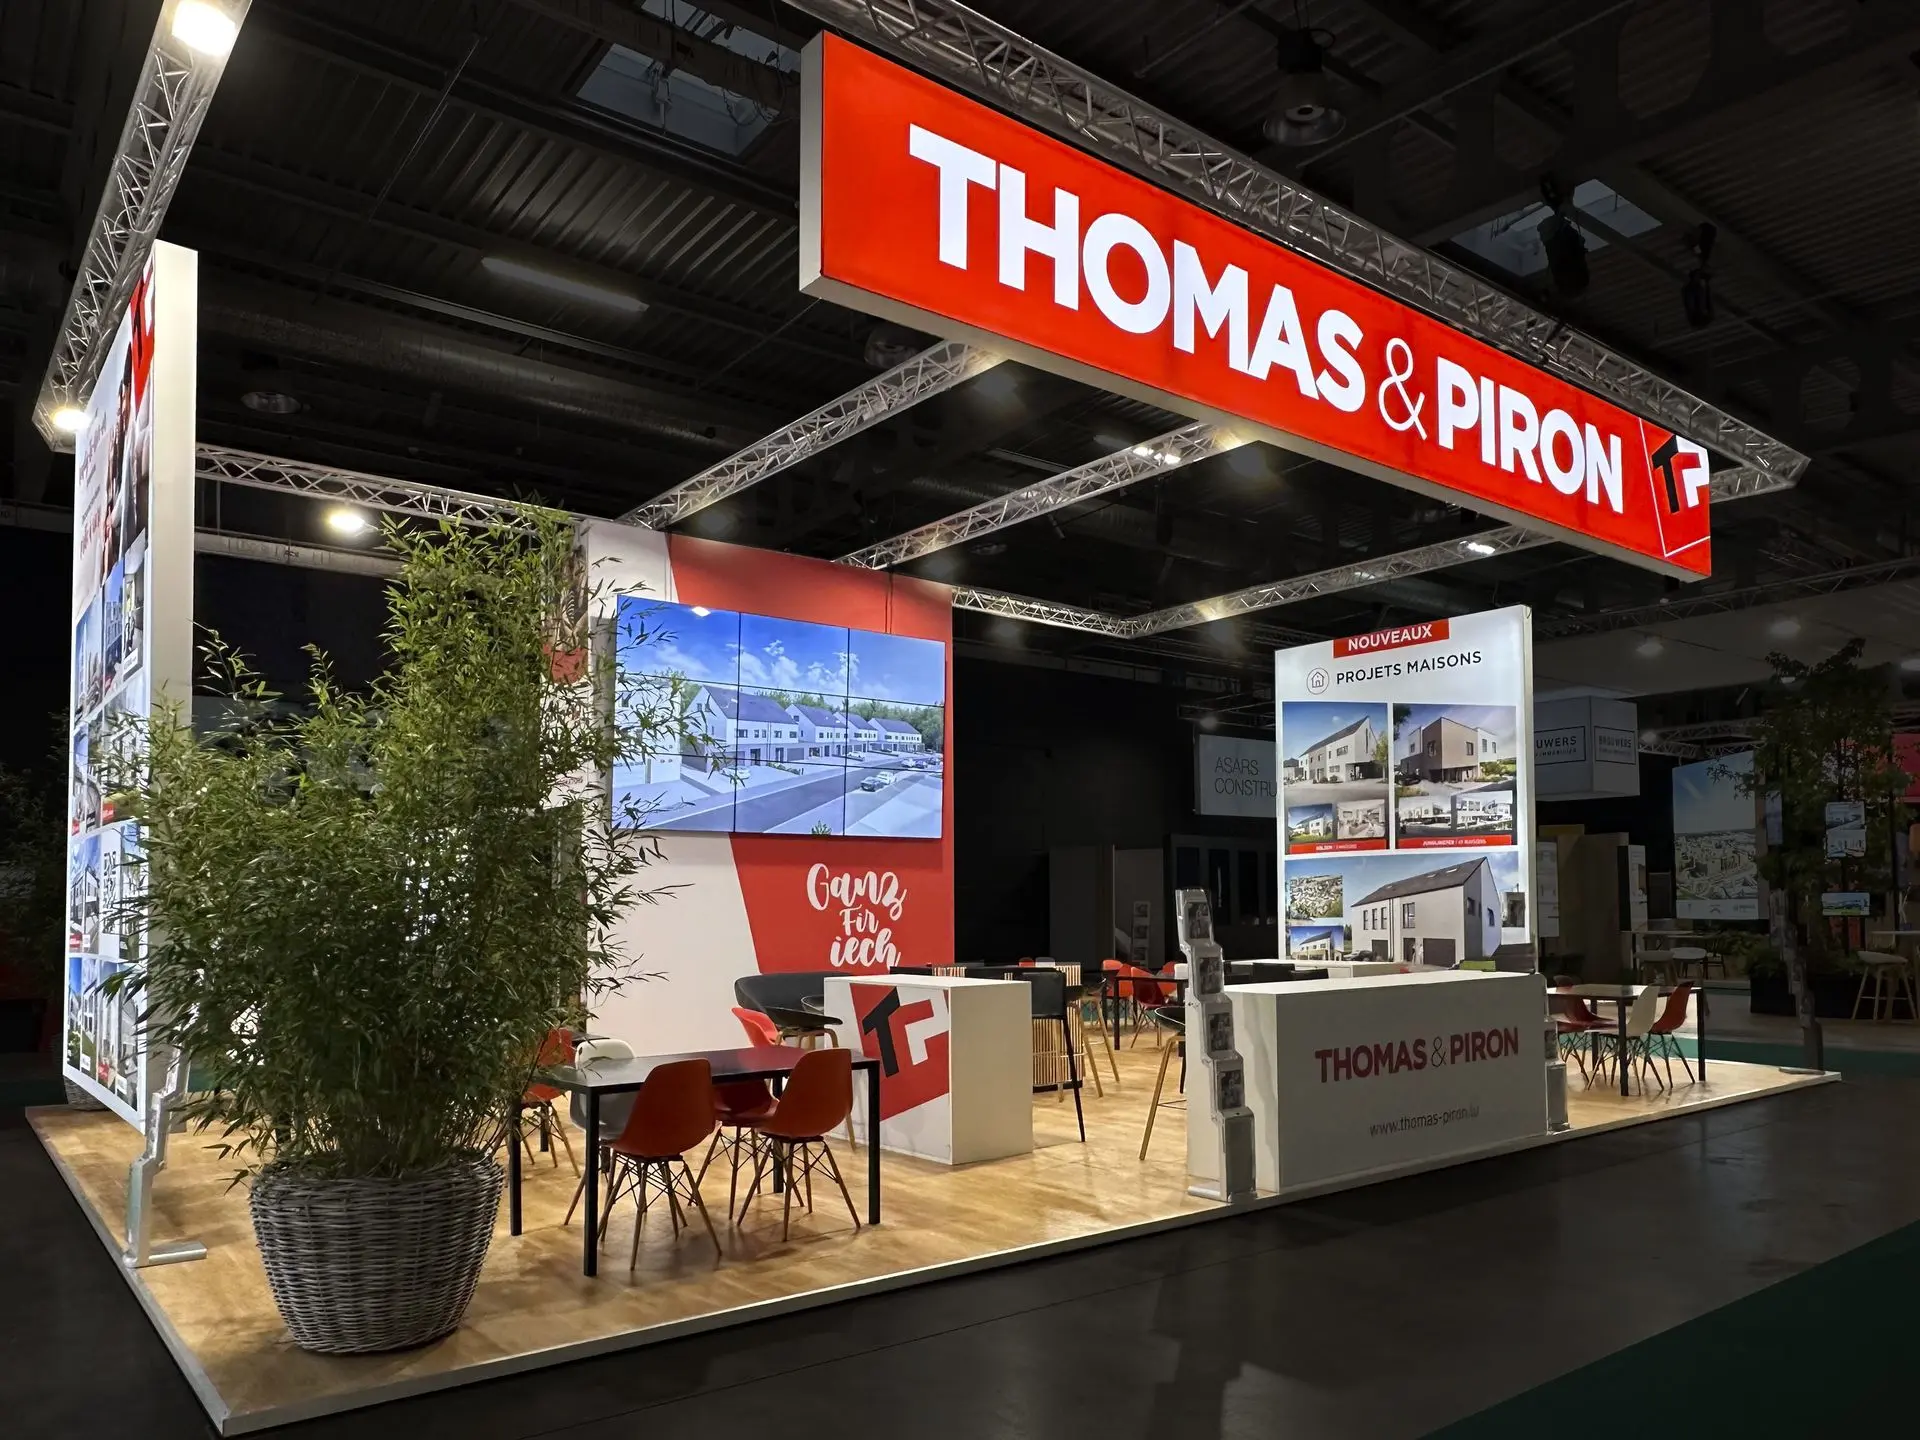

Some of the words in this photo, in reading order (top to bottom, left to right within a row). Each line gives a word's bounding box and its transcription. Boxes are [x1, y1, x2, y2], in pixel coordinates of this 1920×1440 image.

[909, 123, 1366, 412] THOMAS
[1378, 337, 1428, 441] &
[1437, 356, 1624, 514] PIRON
[1348, 624, 1432, 651] NOUVEAUX
[1336, 663, 1402, 685] PROJETS
[1407, 650, 1482, 674] MAISONS
[1214, 756, 1259, 776] ASARS
[1214, 778, 1277, 798] CONSTRU
[806, 862, 908, 921] Ganz
[839, 904, 879, 936] Fir
[829, 927, 902, 973] iech
[1315, 1038, 1427, 1083] THOMAS
[1431, 1036, 1447, 1068] &
[1450, 1027, 1519, 1065] PIRON
[1369, 1102, 1480, 1138] www.thomas-piron.lu
